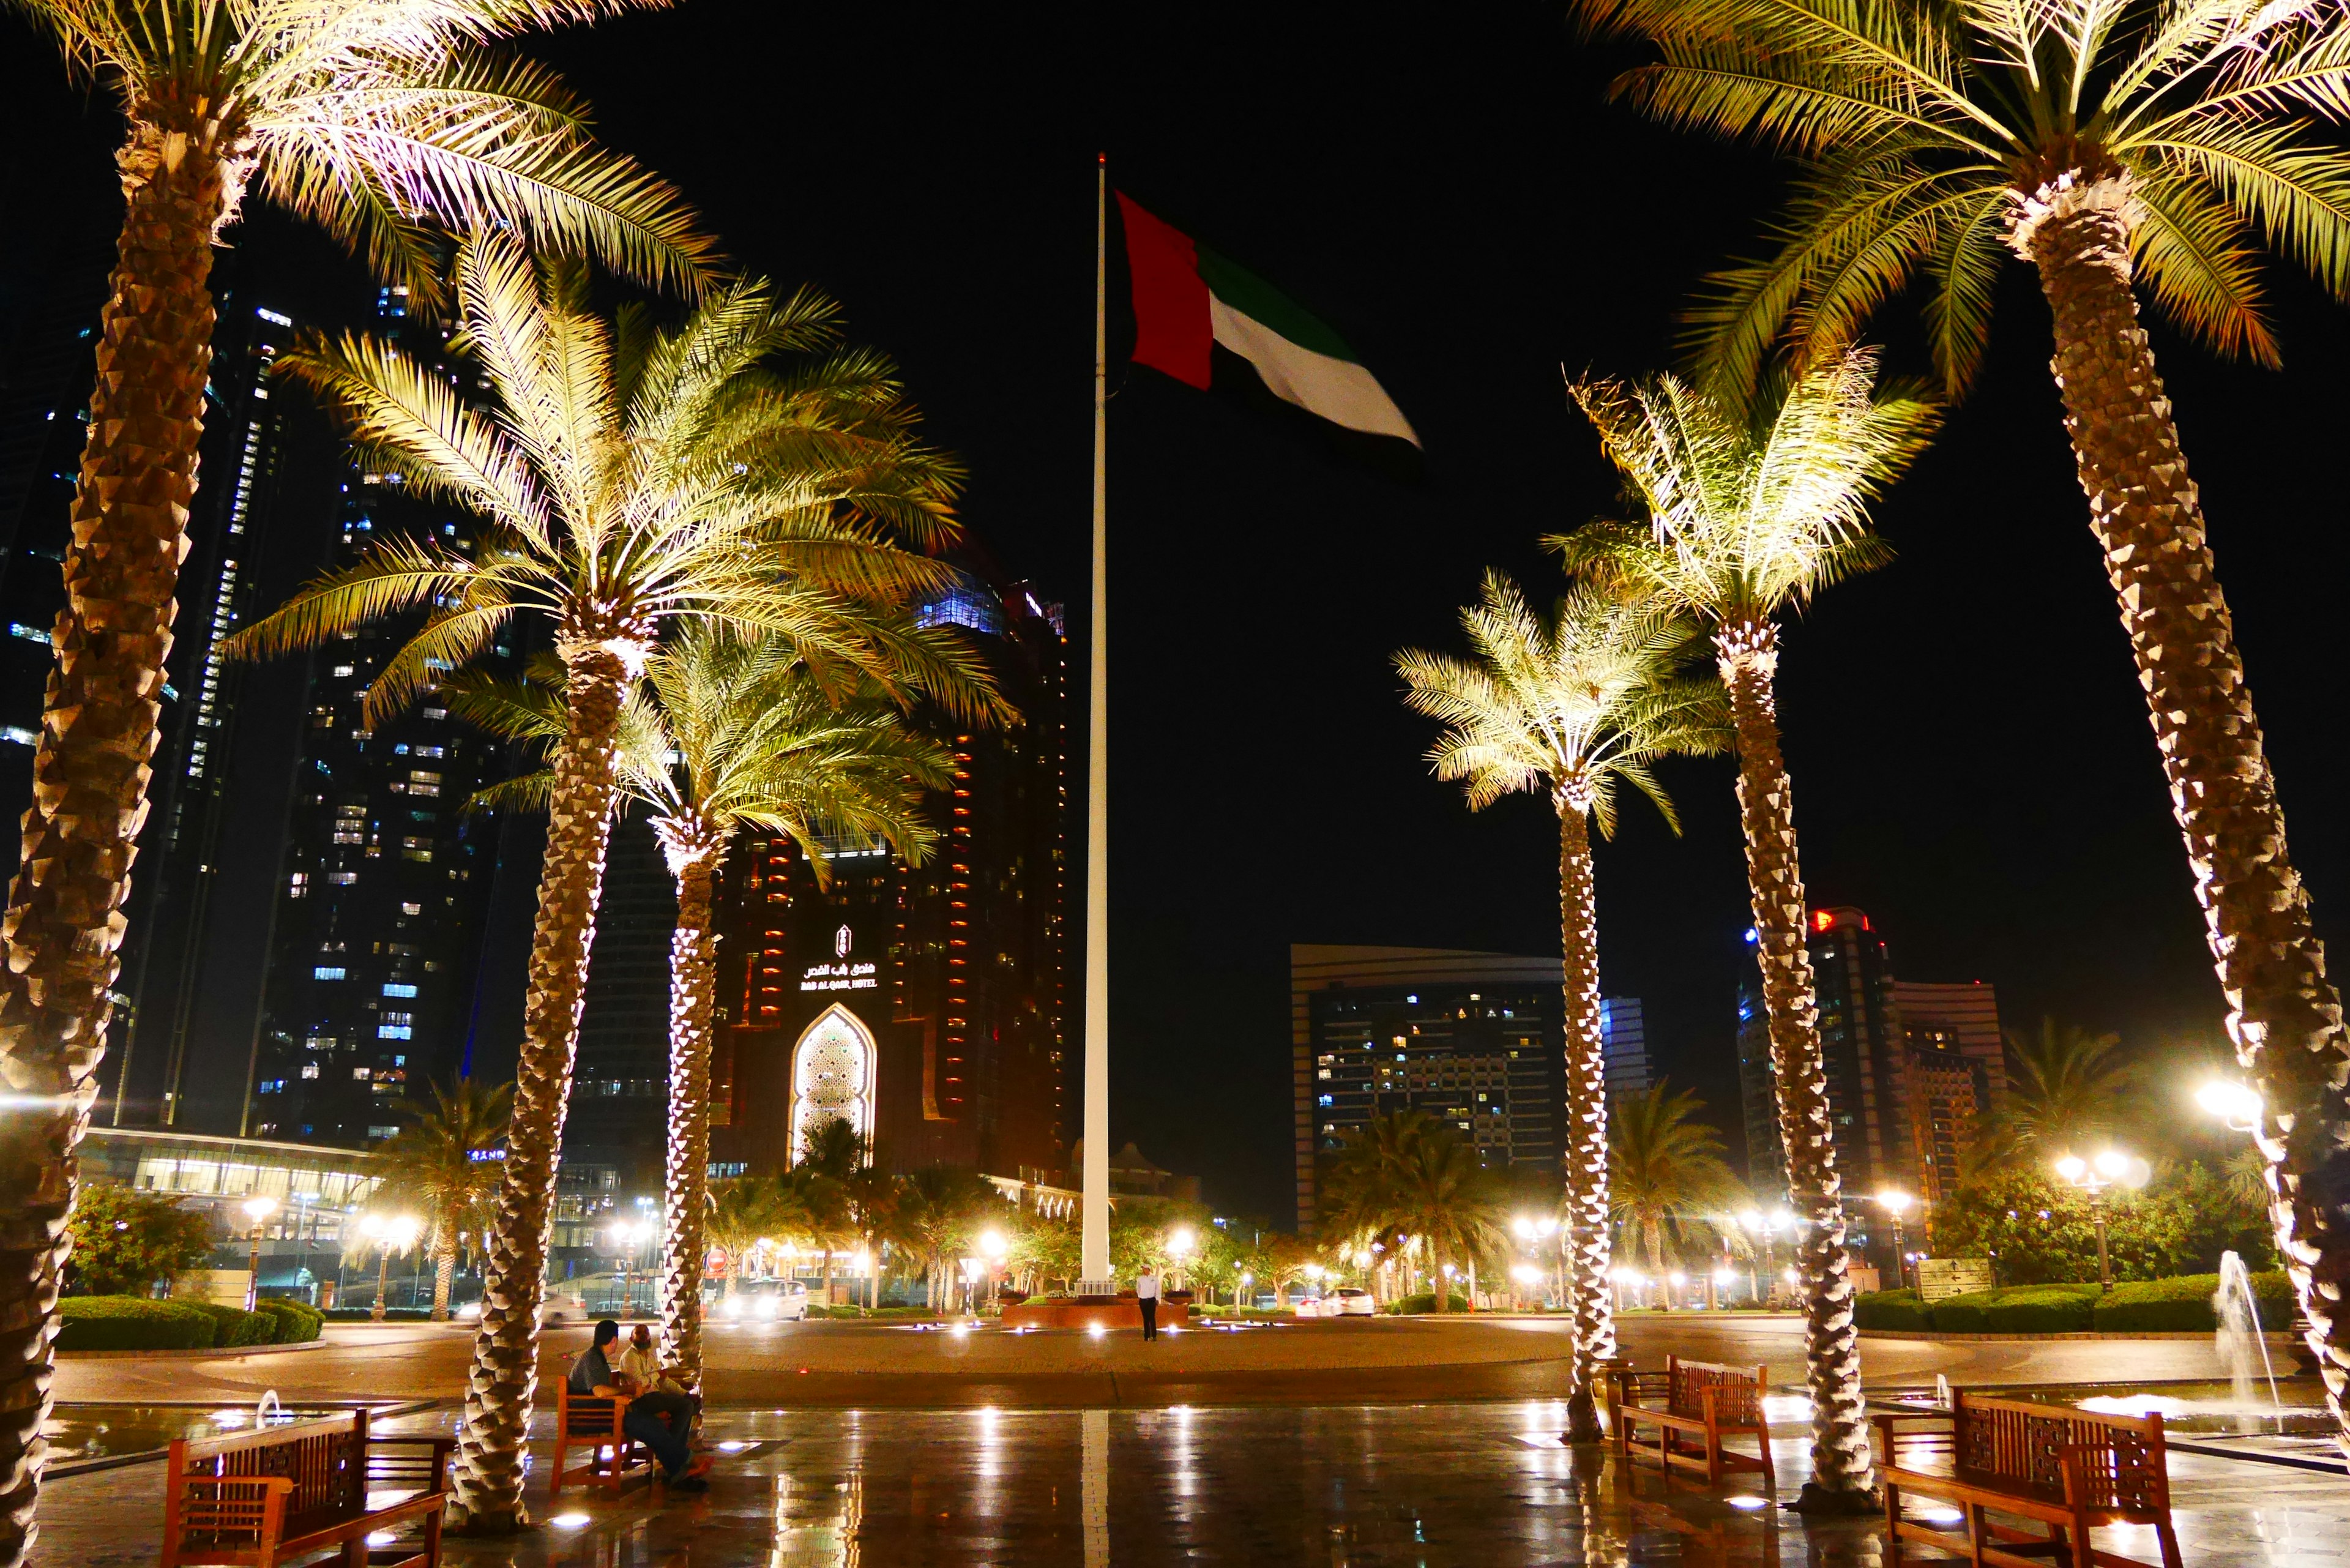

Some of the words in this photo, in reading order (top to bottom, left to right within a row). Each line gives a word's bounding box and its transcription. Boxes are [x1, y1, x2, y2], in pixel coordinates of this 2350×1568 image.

[804, 964, 830, 979] القصر
[850, 963, 875, 976] فندق
[800, 982, 817, 990] BAB
[818, 981, 829, 990] AL
[829, 980, 852, 990] QASR
[851, 979, 878, 988] HOTEL
[466, 1150, 505, 1161] RAND
